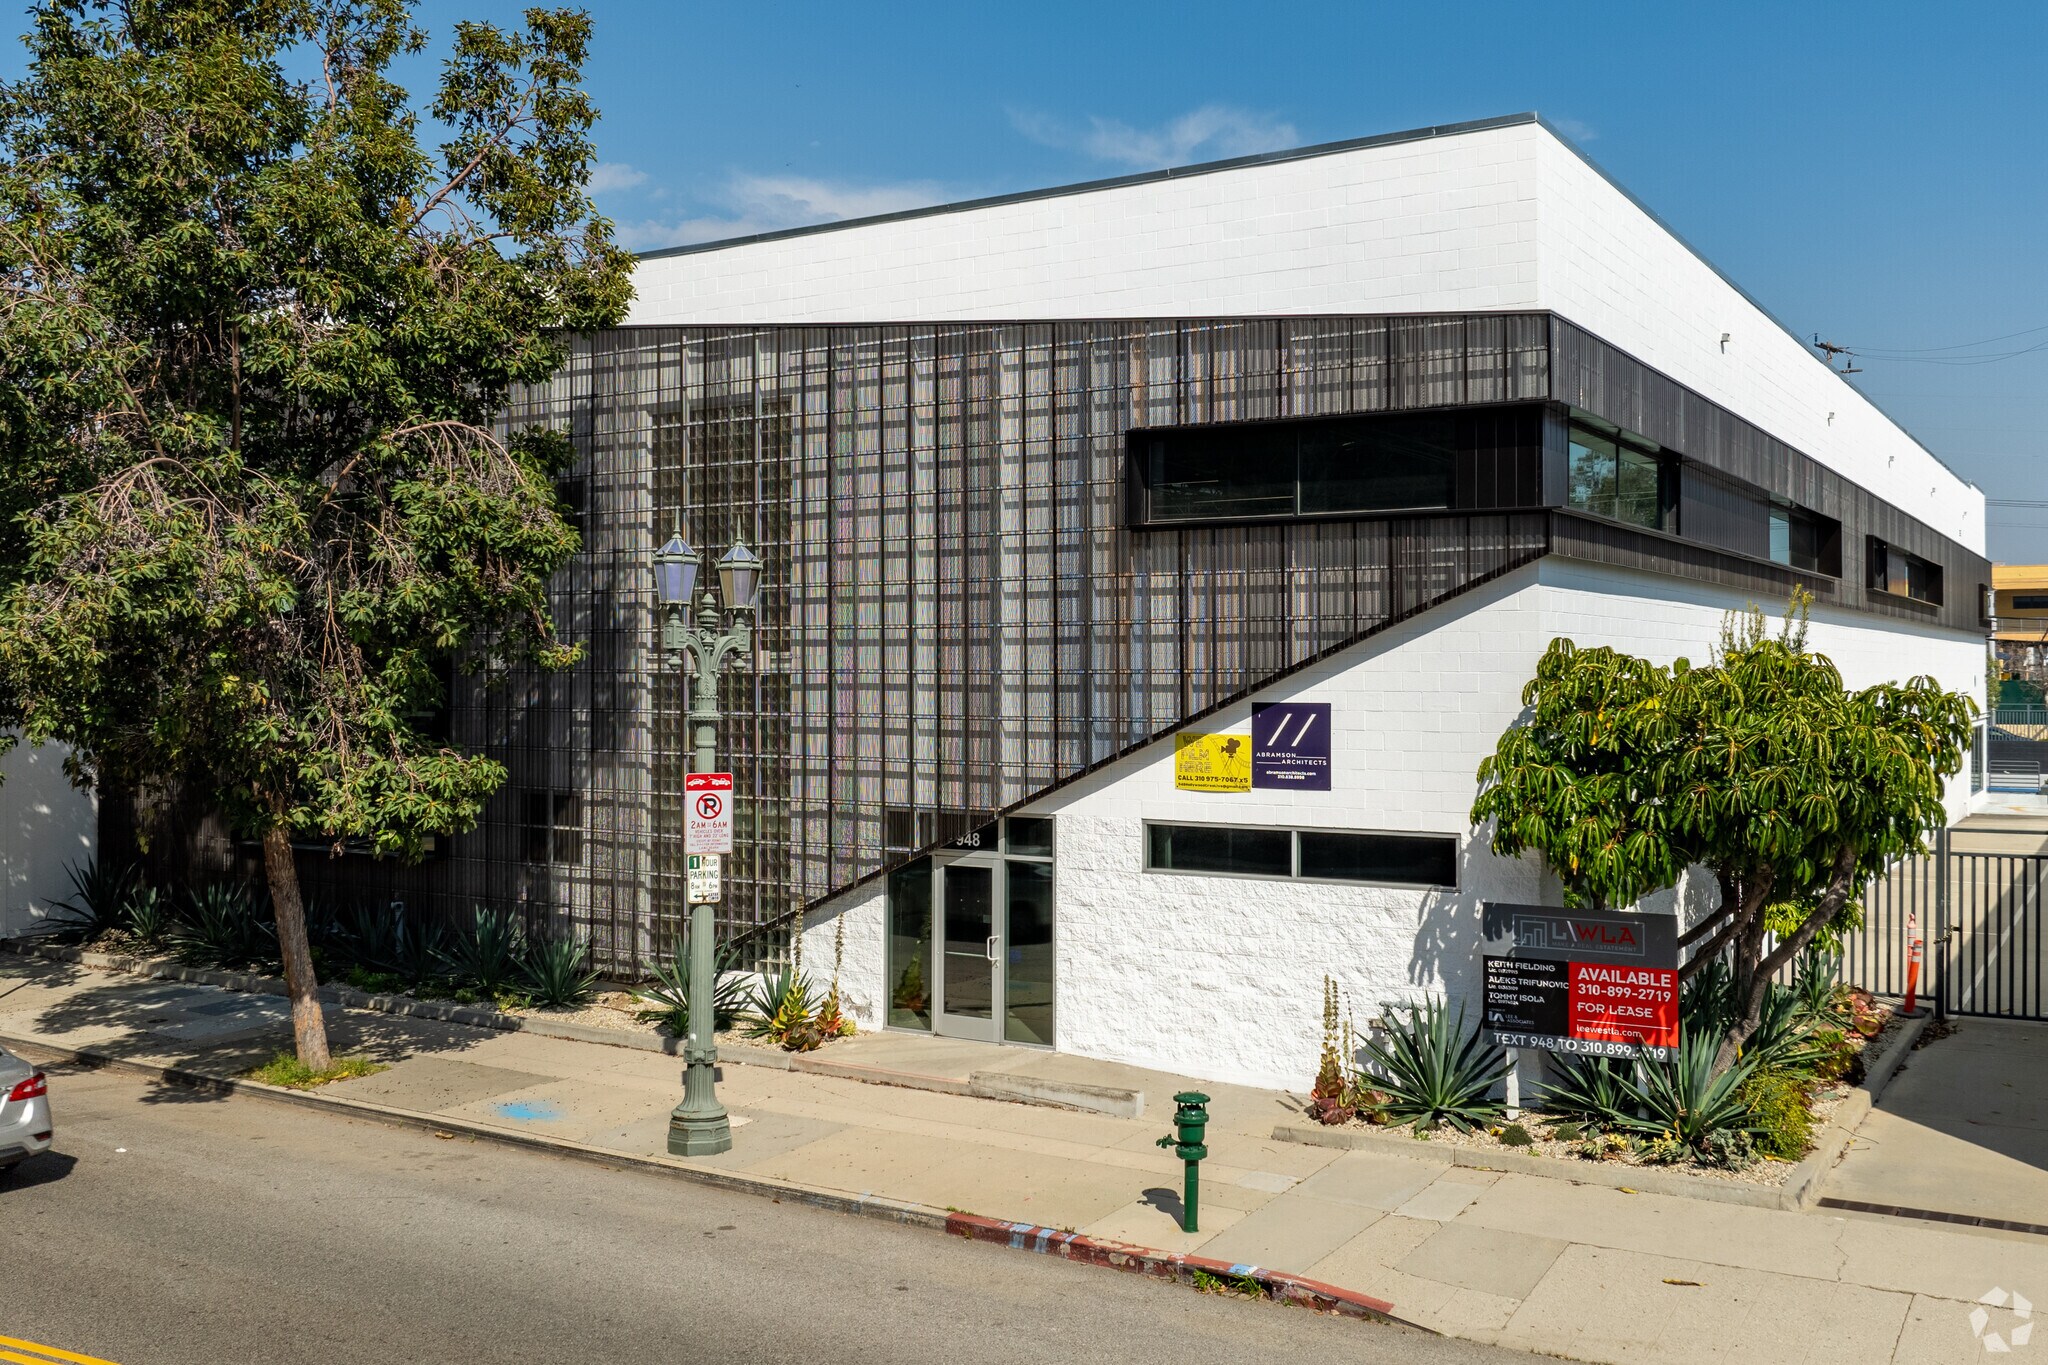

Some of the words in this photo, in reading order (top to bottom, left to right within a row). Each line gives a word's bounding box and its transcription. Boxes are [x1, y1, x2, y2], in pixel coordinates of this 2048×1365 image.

[1180, 748, 1209, 760] FILM
[1179, 761, 1212, 773] HERE
[690, 870, 719, 880] PARKING
[1488, 960, 1513, 969] KEITH
[1515, 962, 1556, 972] FIELDING
[1488, 975, 1517, 985] ALEKS
[1518, 978, 1570, 990] TRIFUNOVIC
[1577, 967, 1671, 988] AVAILABLE
[1488, 991, 1518, 1001] TOMMY
[1519, 994, 1546, 1004] ISOLA
[1577, 983, 1671, 1003] 310-899-2719
[1577, 1002, 1605, 1014] FOR
[1609, 1005, 1654, 1018] LEASE
[1576, 1024, 1642, 1038] leewestla.com
[1493, 1032, 1527, 1046] TEXT
[1530, 1036, 1554, 1049] 948
[1557, 1038, 1578, 1051] TO
